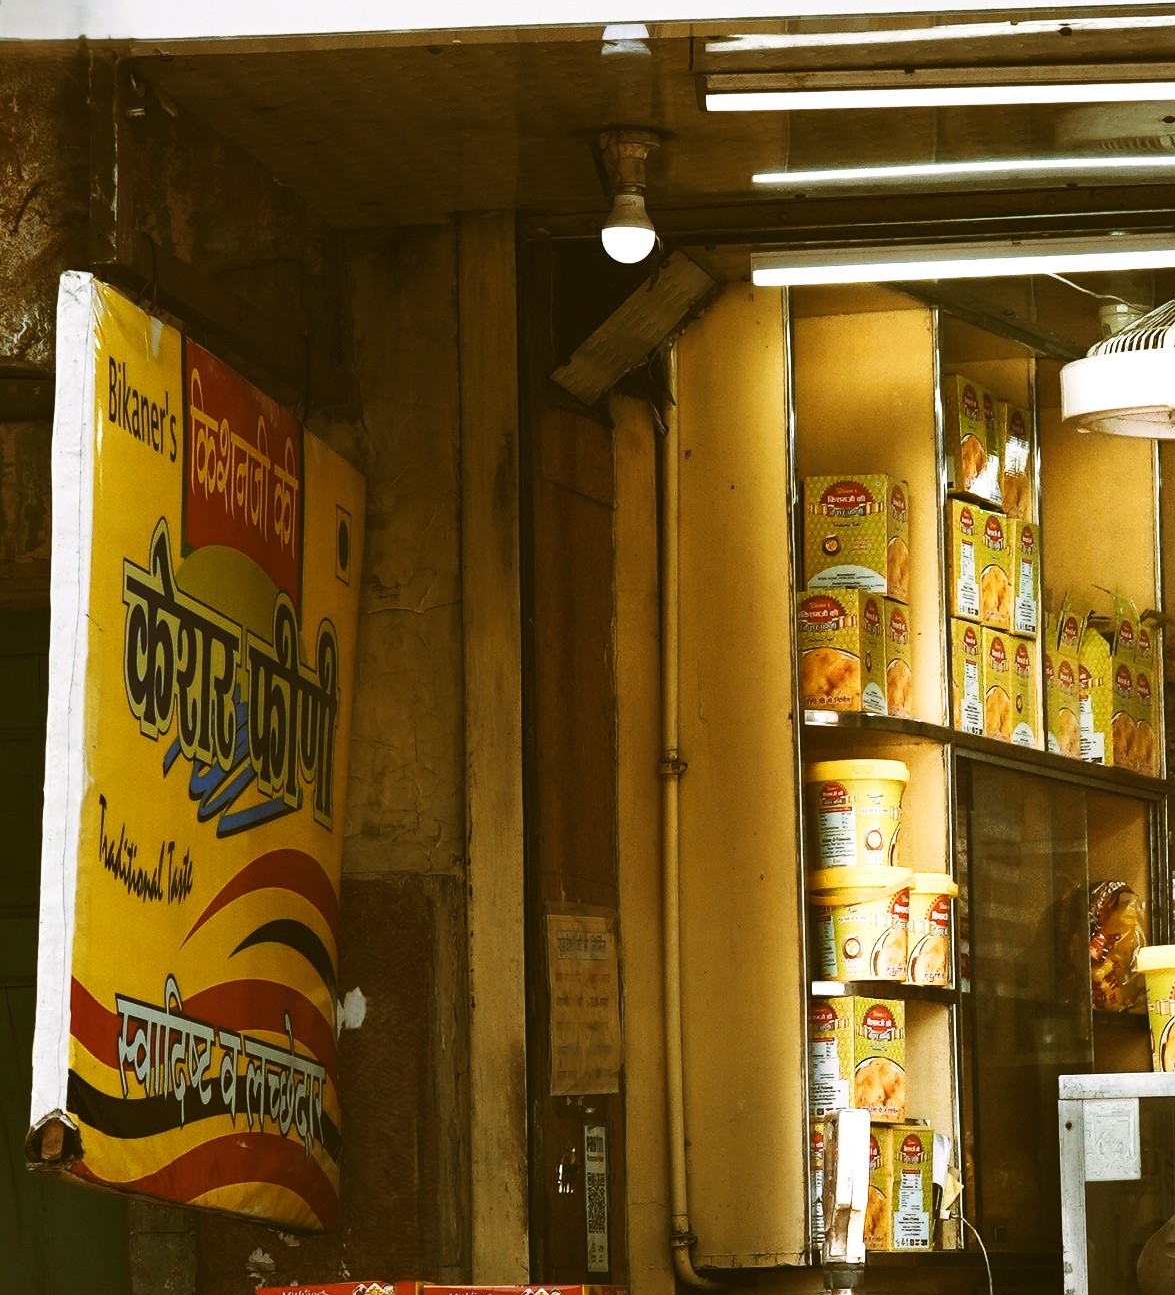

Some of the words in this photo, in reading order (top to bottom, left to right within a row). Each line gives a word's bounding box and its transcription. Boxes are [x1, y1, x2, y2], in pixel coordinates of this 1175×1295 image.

[108, 356, 178, 462] Bikaner's
[190, 367, 271, 541] किशनजी
[273, 436, 299, 559] की
[123, 516, 242, 771] केशर
[219, 1029, 241, 1129] व
